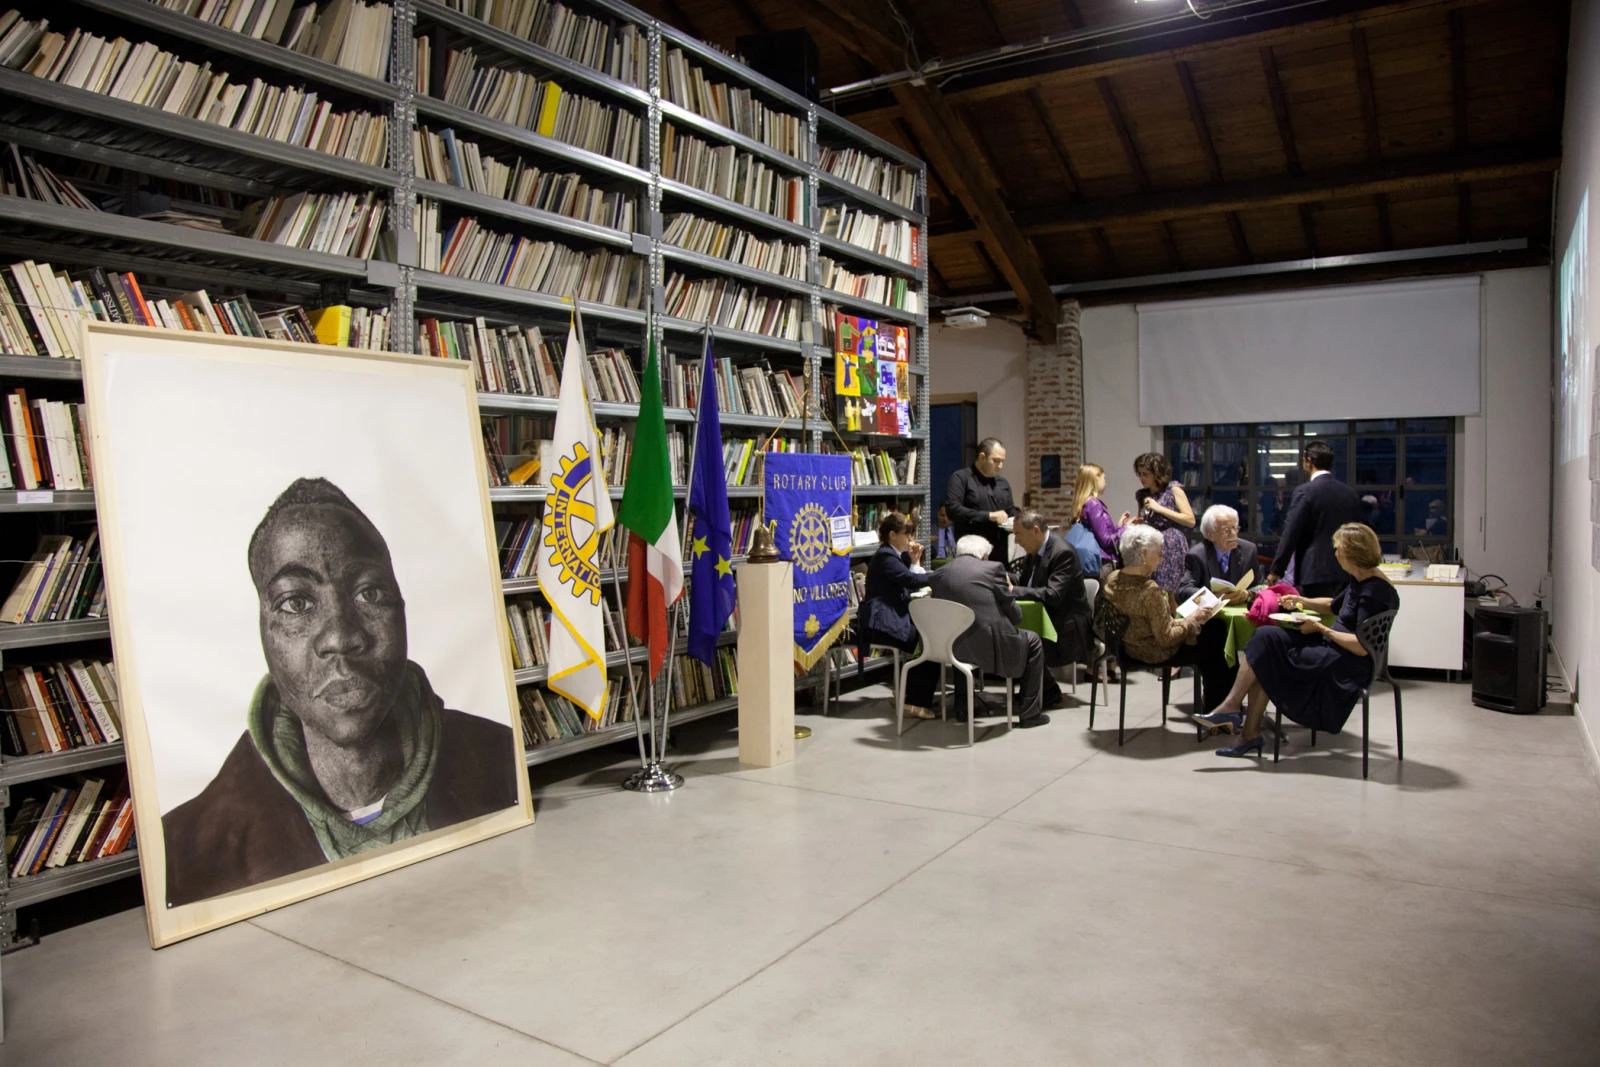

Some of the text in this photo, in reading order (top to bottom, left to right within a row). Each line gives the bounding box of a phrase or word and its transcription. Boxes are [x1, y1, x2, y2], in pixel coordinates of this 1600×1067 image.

[773, 474, 848, 491] ROTARY CLUB
[555, 494, 601, 588] INTERNATIO
